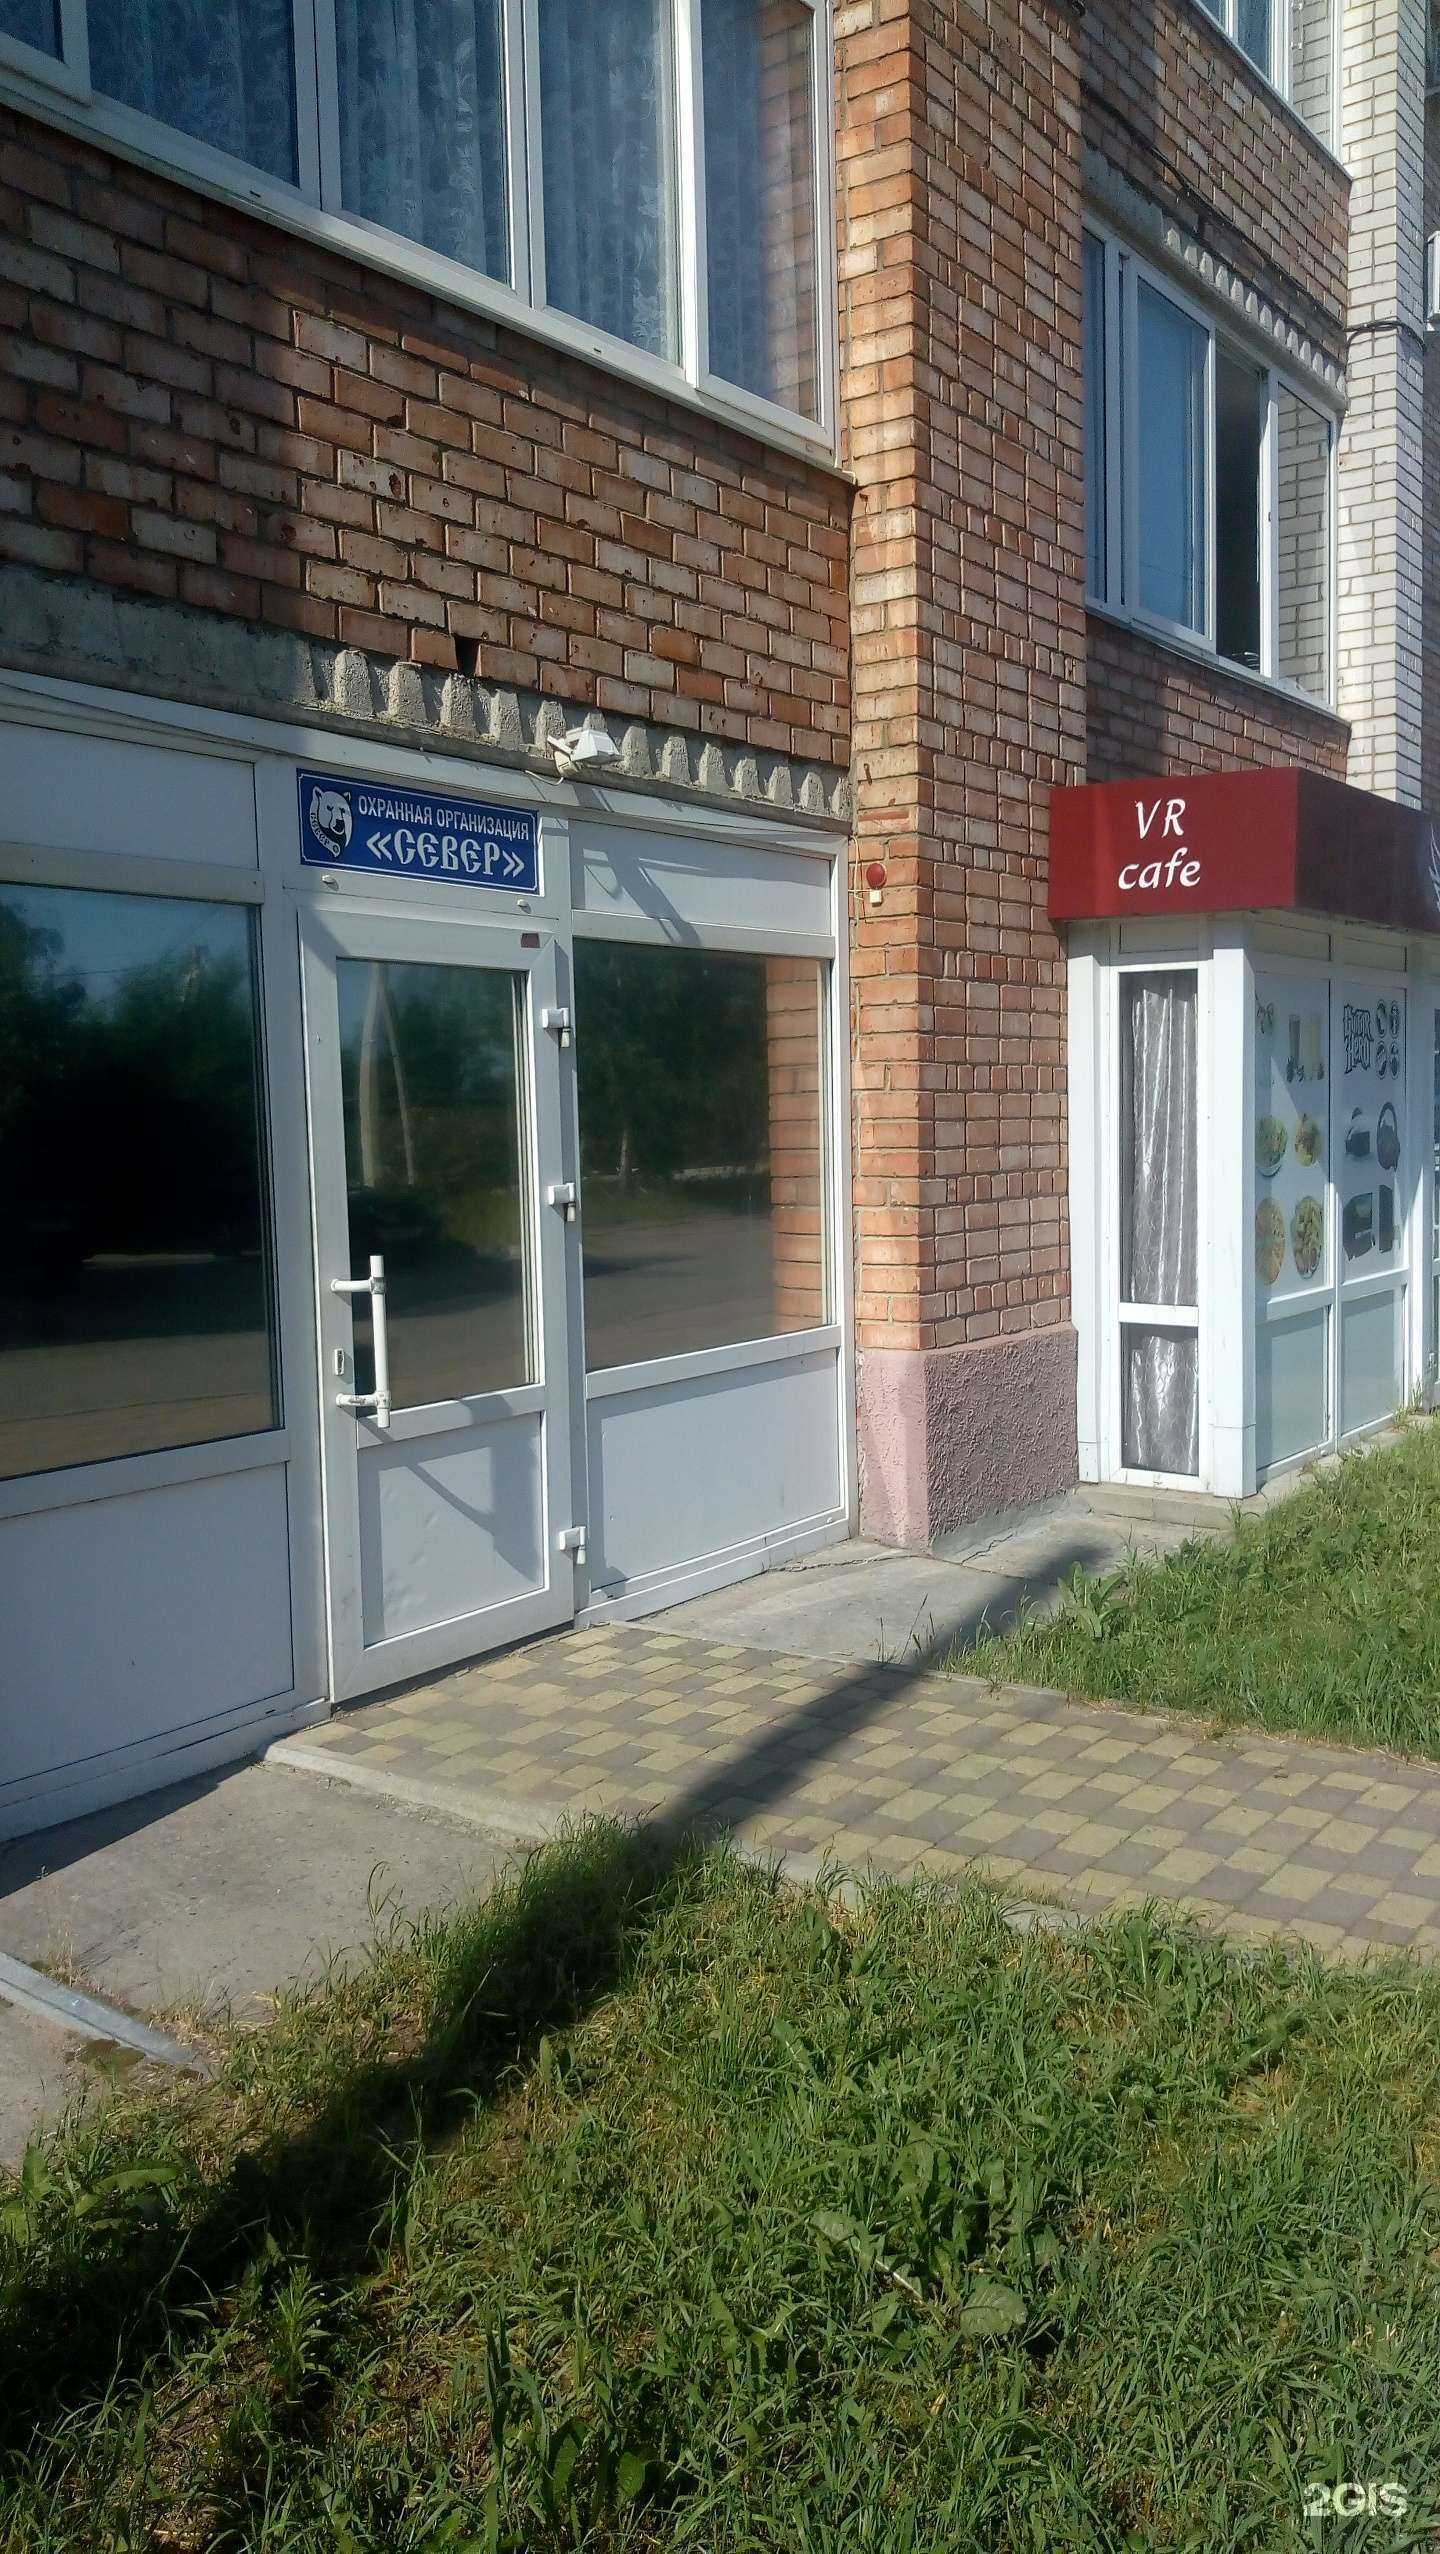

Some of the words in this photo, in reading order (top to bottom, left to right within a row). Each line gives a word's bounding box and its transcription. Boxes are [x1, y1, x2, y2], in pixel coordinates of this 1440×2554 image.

[358, 795, 432, 825] ОХРАННАЯ
[436, 808, 529, 841] ОРГАНИЗАЦИЯ
[1135, 798, 1186, 840] VR
[1117, 846, 1201, 890] cafe
